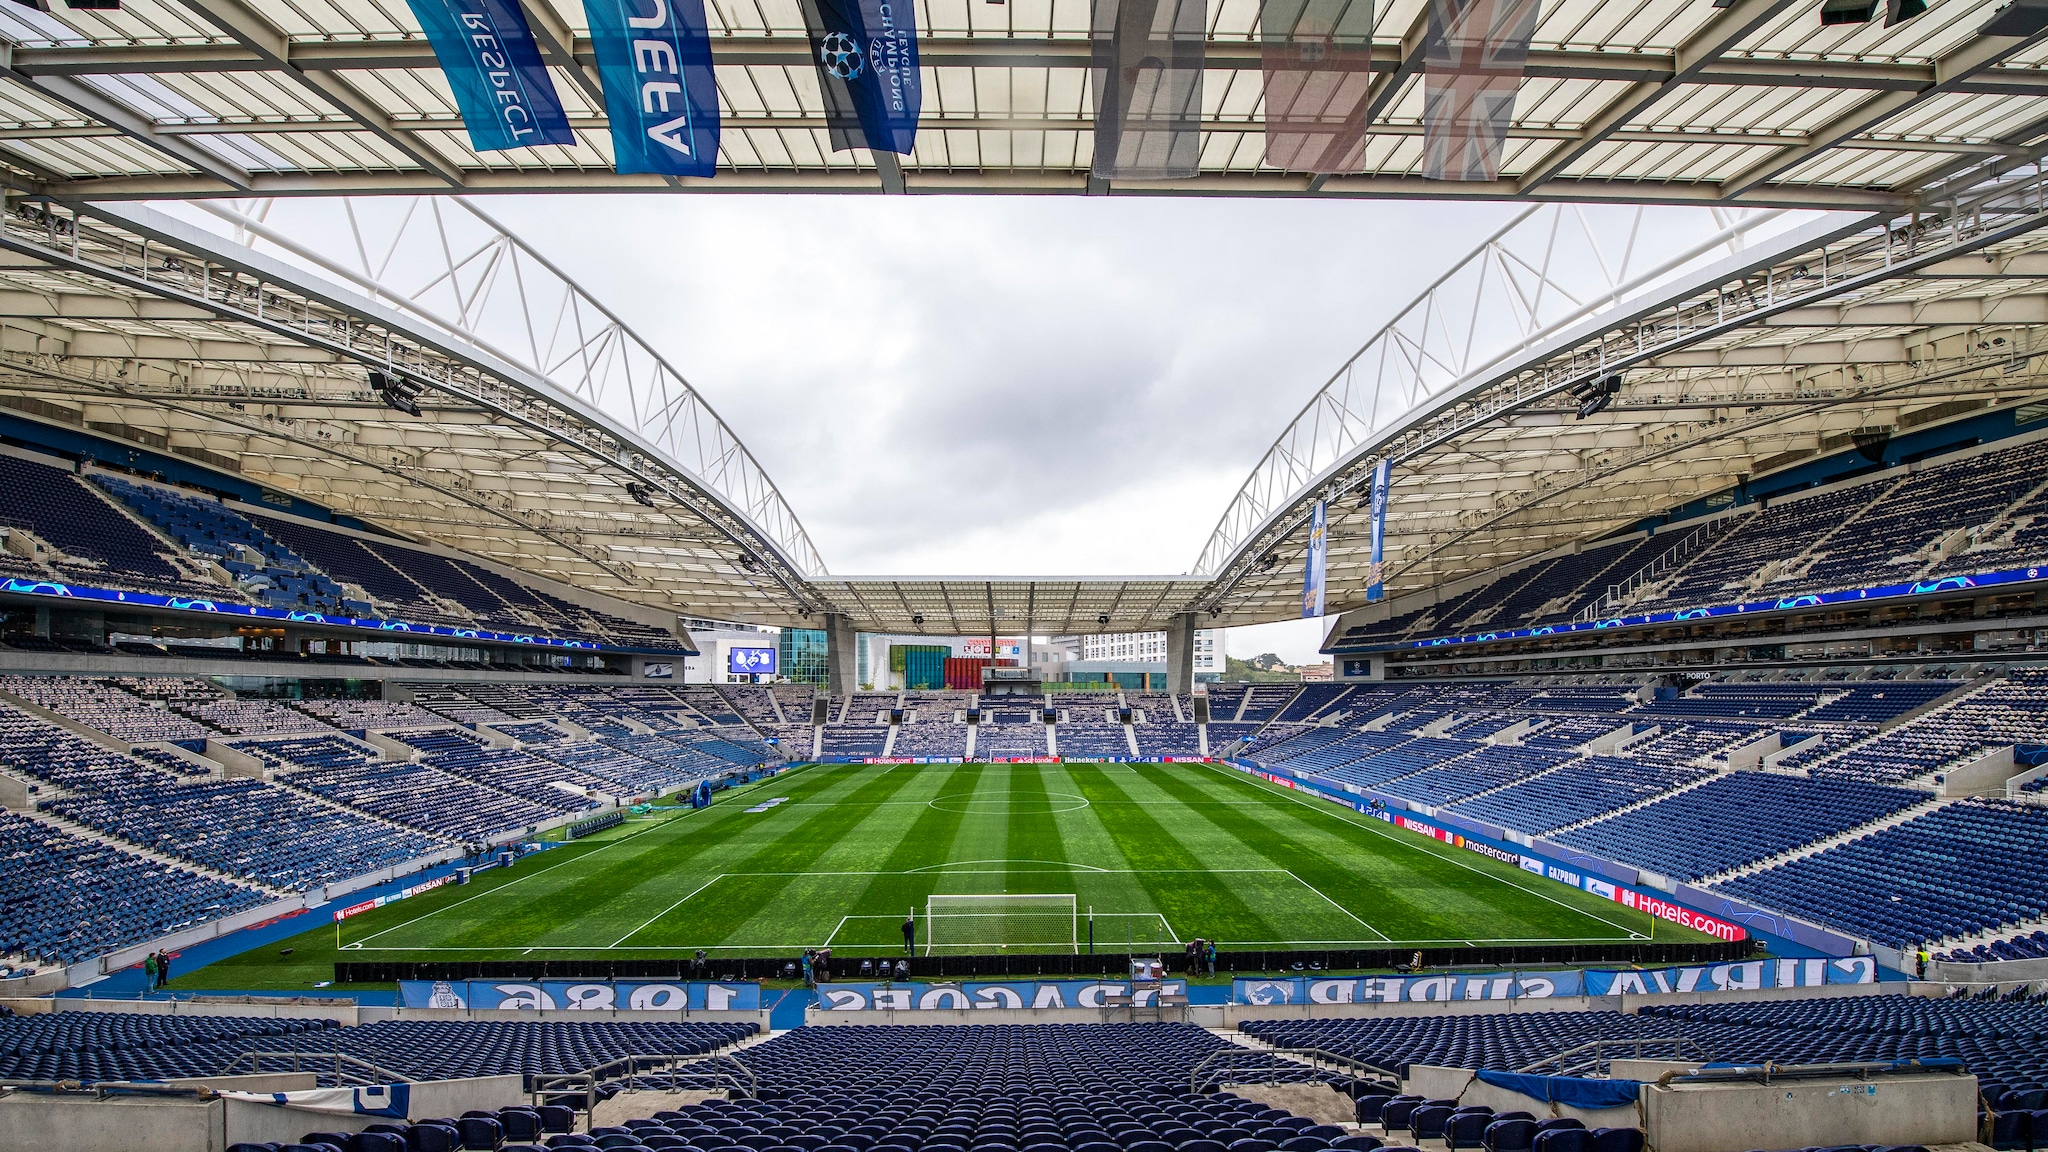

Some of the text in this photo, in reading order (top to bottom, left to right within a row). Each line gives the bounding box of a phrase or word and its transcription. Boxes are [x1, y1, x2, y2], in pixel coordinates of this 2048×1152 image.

[1686, 672, 1711, 680] PORTO
[1366, 806, 1383, 820] PS4
[1403, 818, 1436, 838] NISSAN
[1465, 839, 1518, 864] mastercard
[1548, 865, 1580, 888] GAZPROM
[411, 878, 443, 896] NISSAN
[345, 902, 374, 917] Hotels.com
[1639, 894, 1733, 942] Hotels.com
